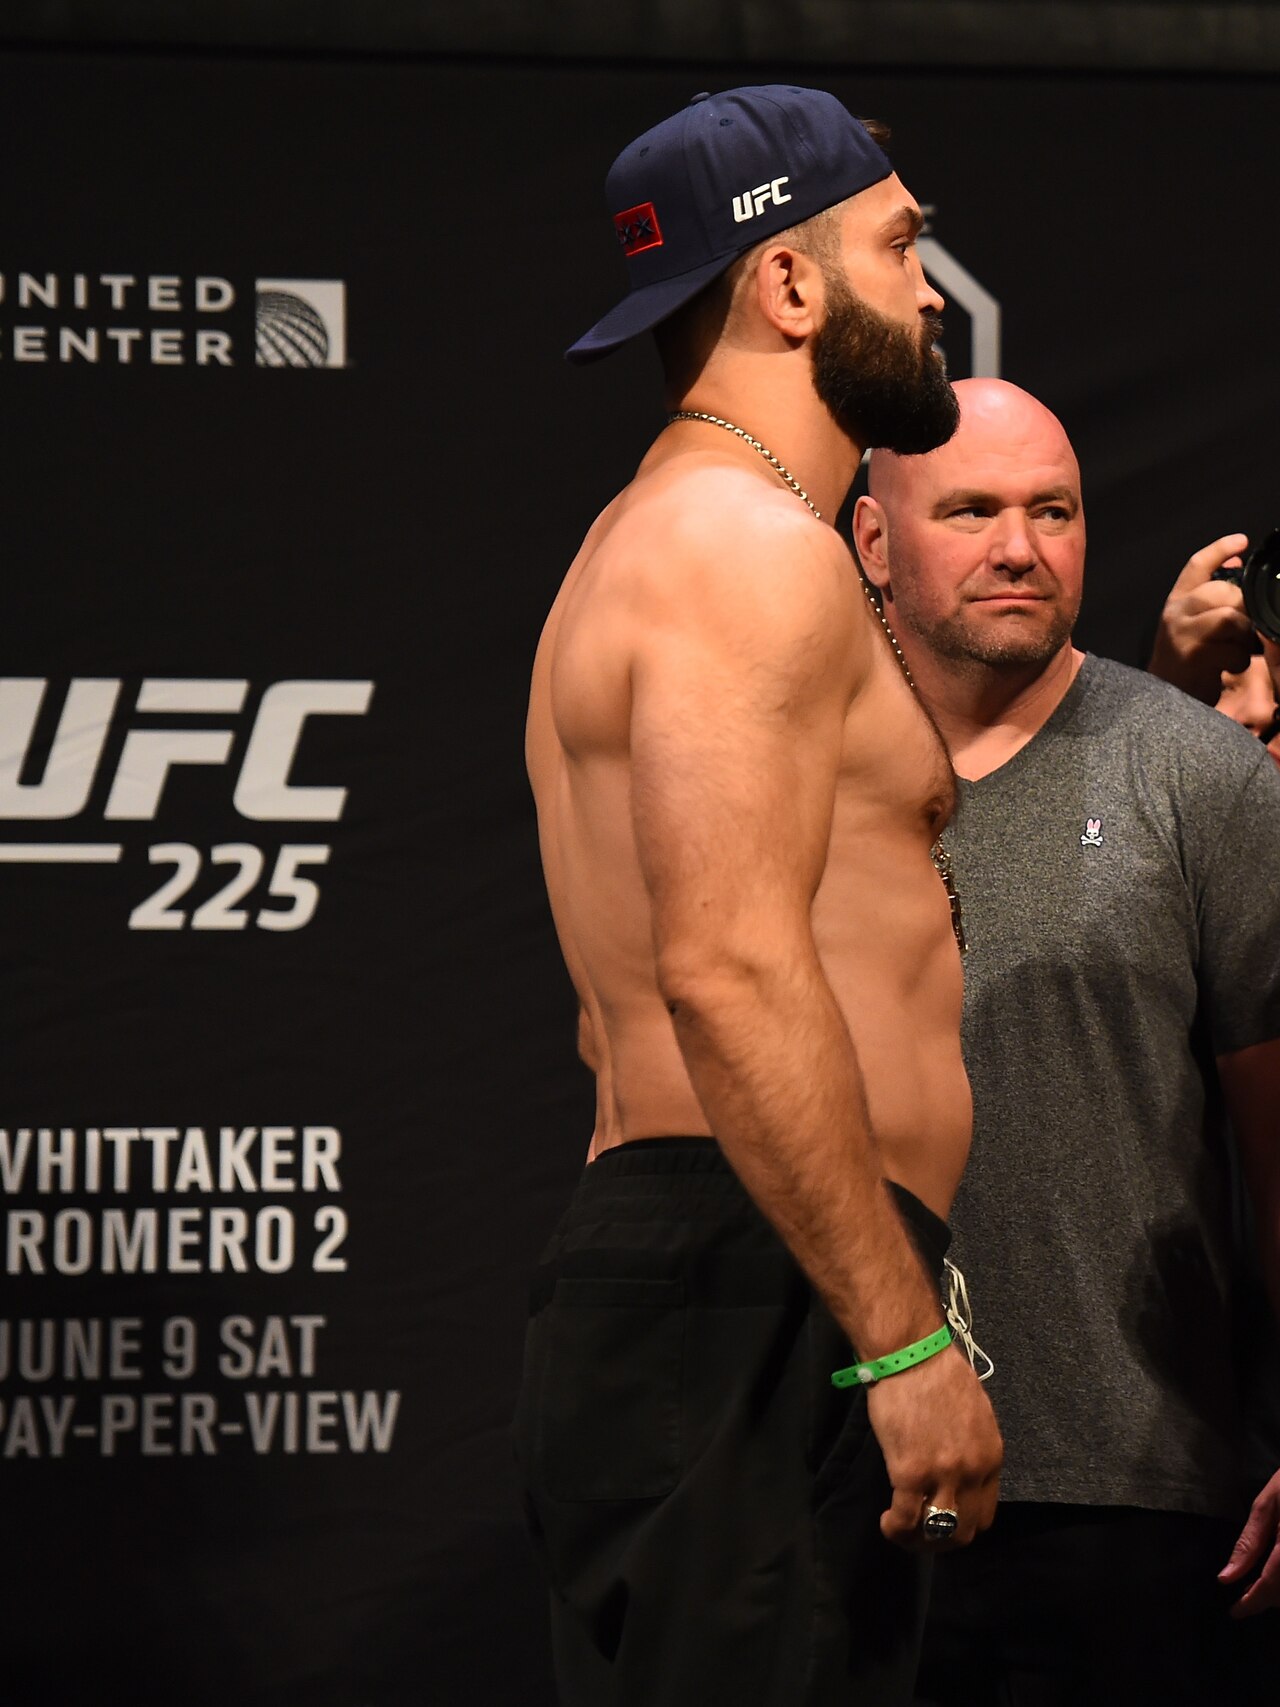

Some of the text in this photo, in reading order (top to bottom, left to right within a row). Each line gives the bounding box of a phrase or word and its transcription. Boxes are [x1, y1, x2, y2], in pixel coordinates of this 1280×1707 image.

[732, 176, 792, 223] UFC
[0, 272, 237, 312] NITED
[0, 325, 235, 367] ENTER
[0, 677, 375, 822] UFC
[127, 841, 332, 932] 225
[6, 1205, 349, 1276] ROMERO 2
[162, 1316, 197, 1381] 9
[218, 1315, 327, 1380] SAT
[0, 1390, 401, 1459] AY-PER-VIEW
